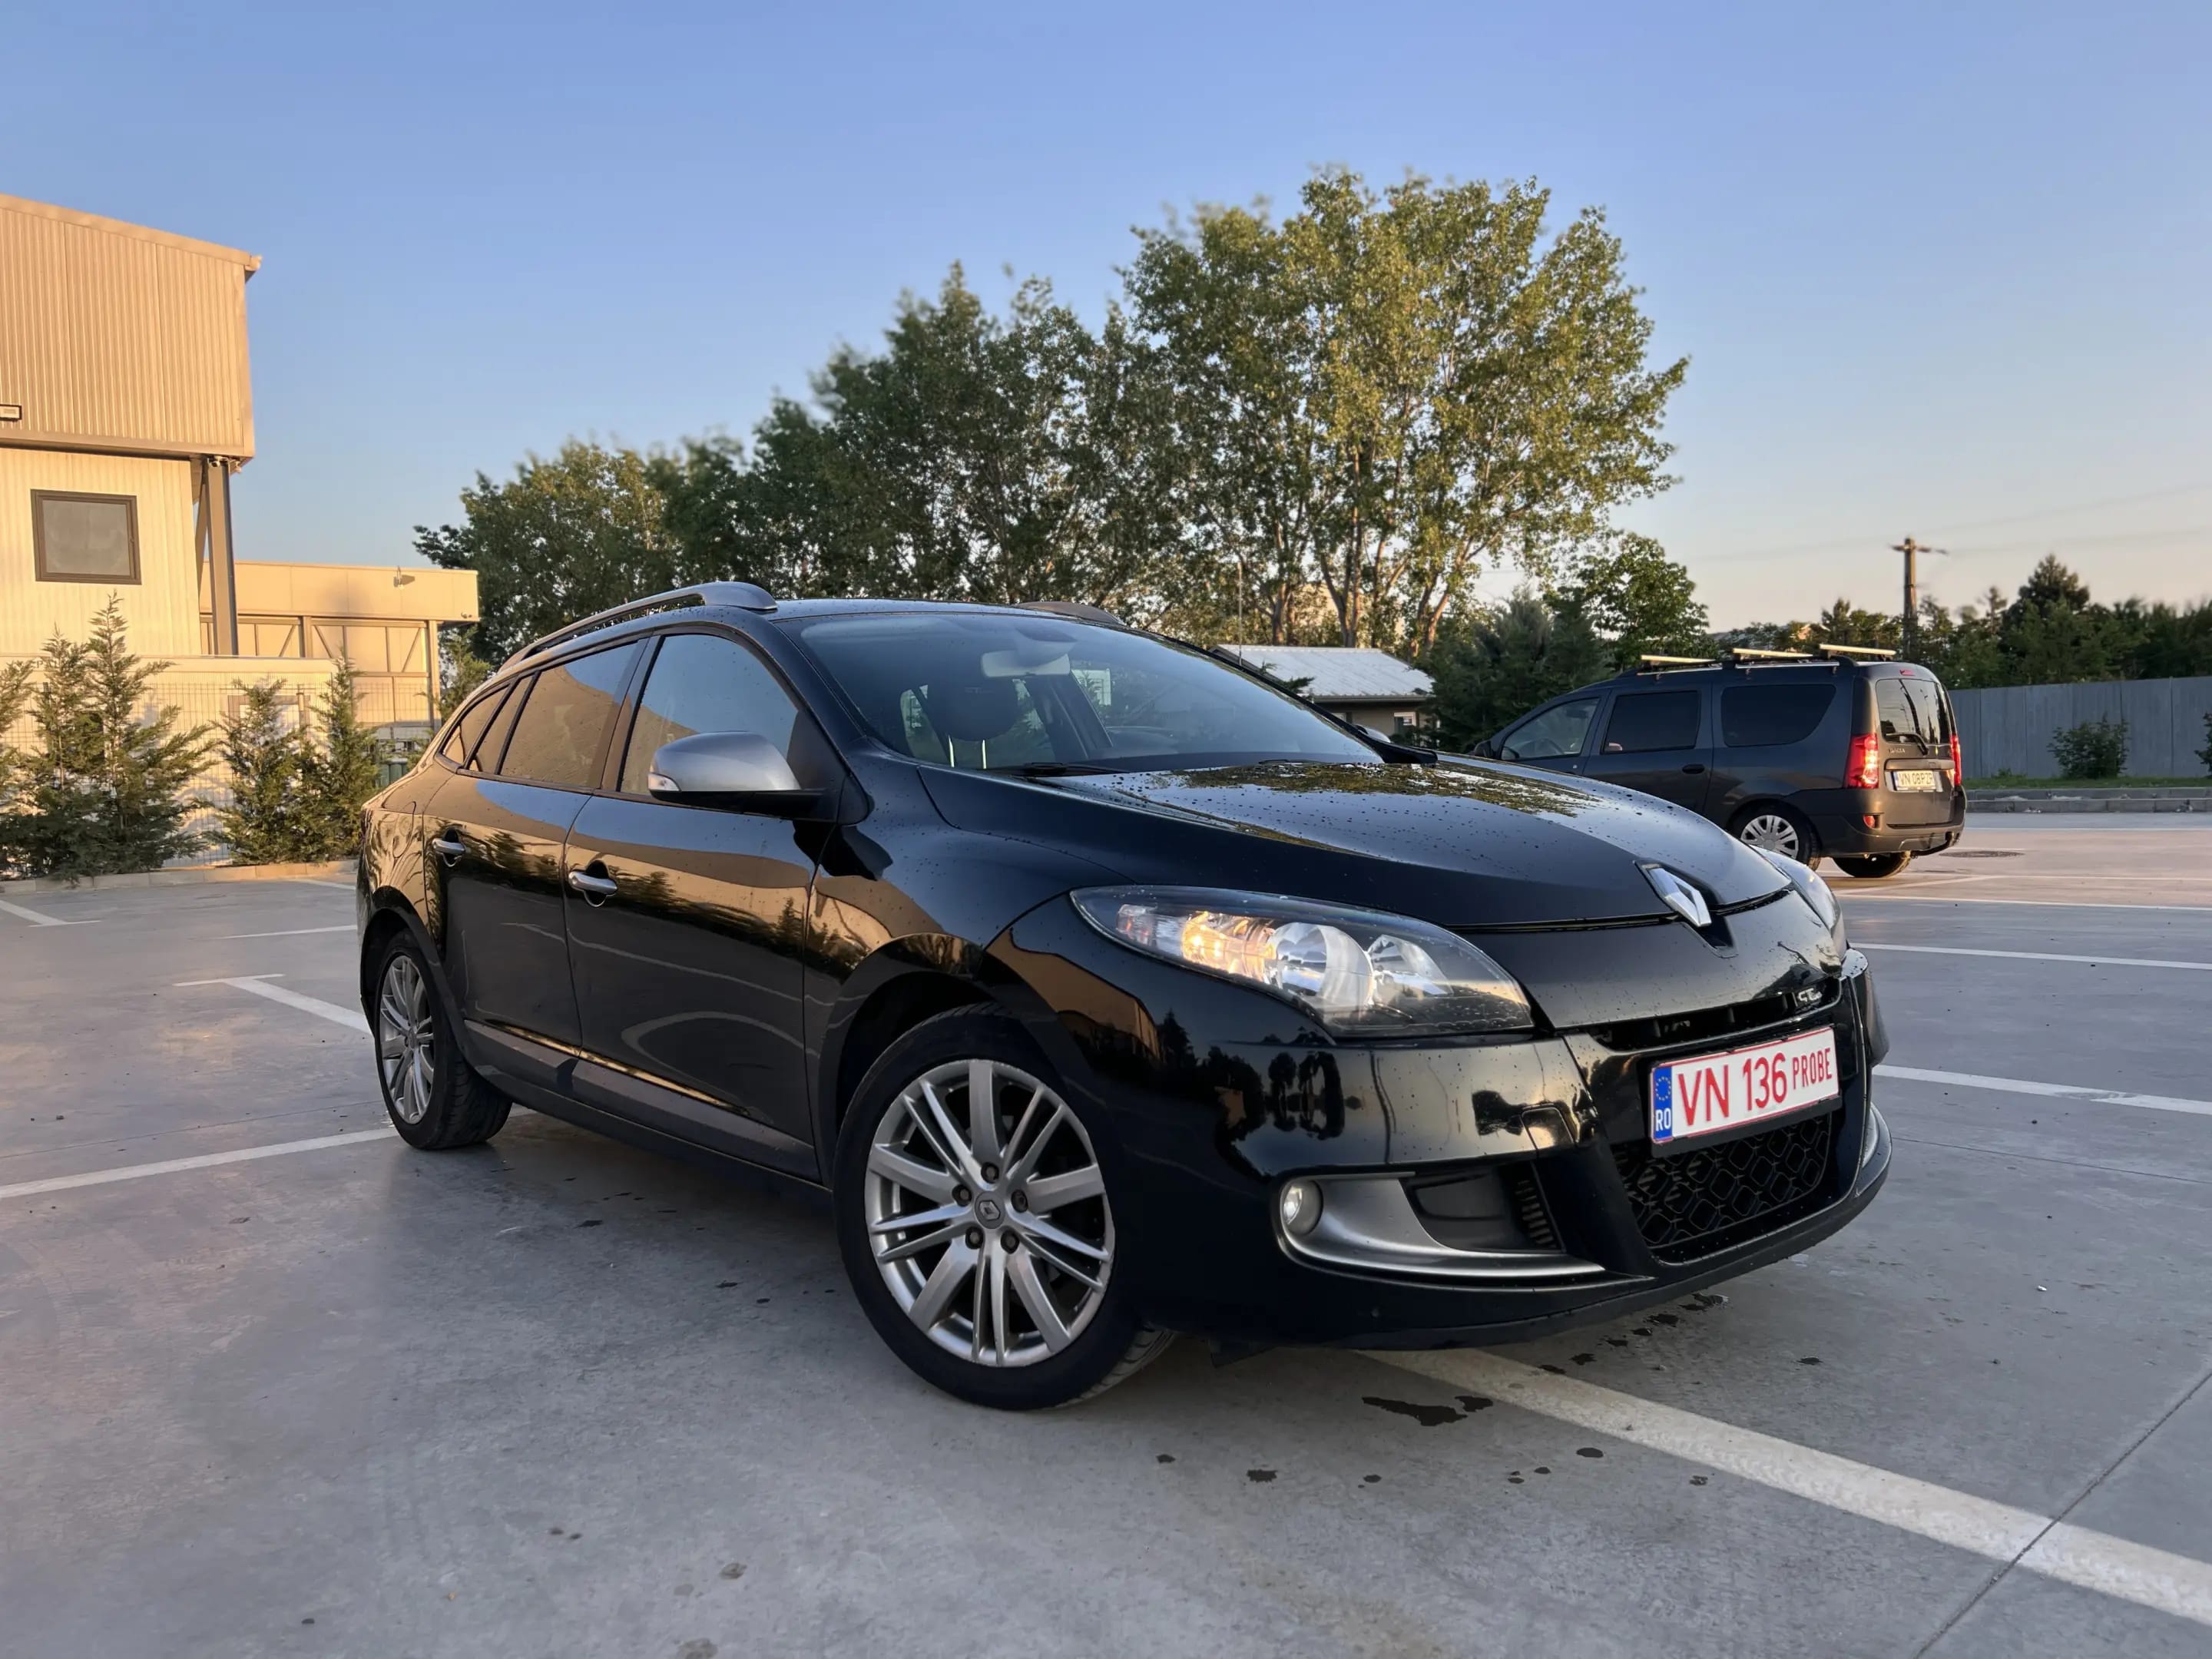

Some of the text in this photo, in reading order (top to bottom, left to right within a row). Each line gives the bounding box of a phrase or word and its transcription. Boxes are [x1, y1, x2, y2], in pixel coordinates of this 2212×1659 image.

[1677, 1048, 1833, 1127] VN 136 PROBE
[1655, 1108, 1672, 1132] RO
